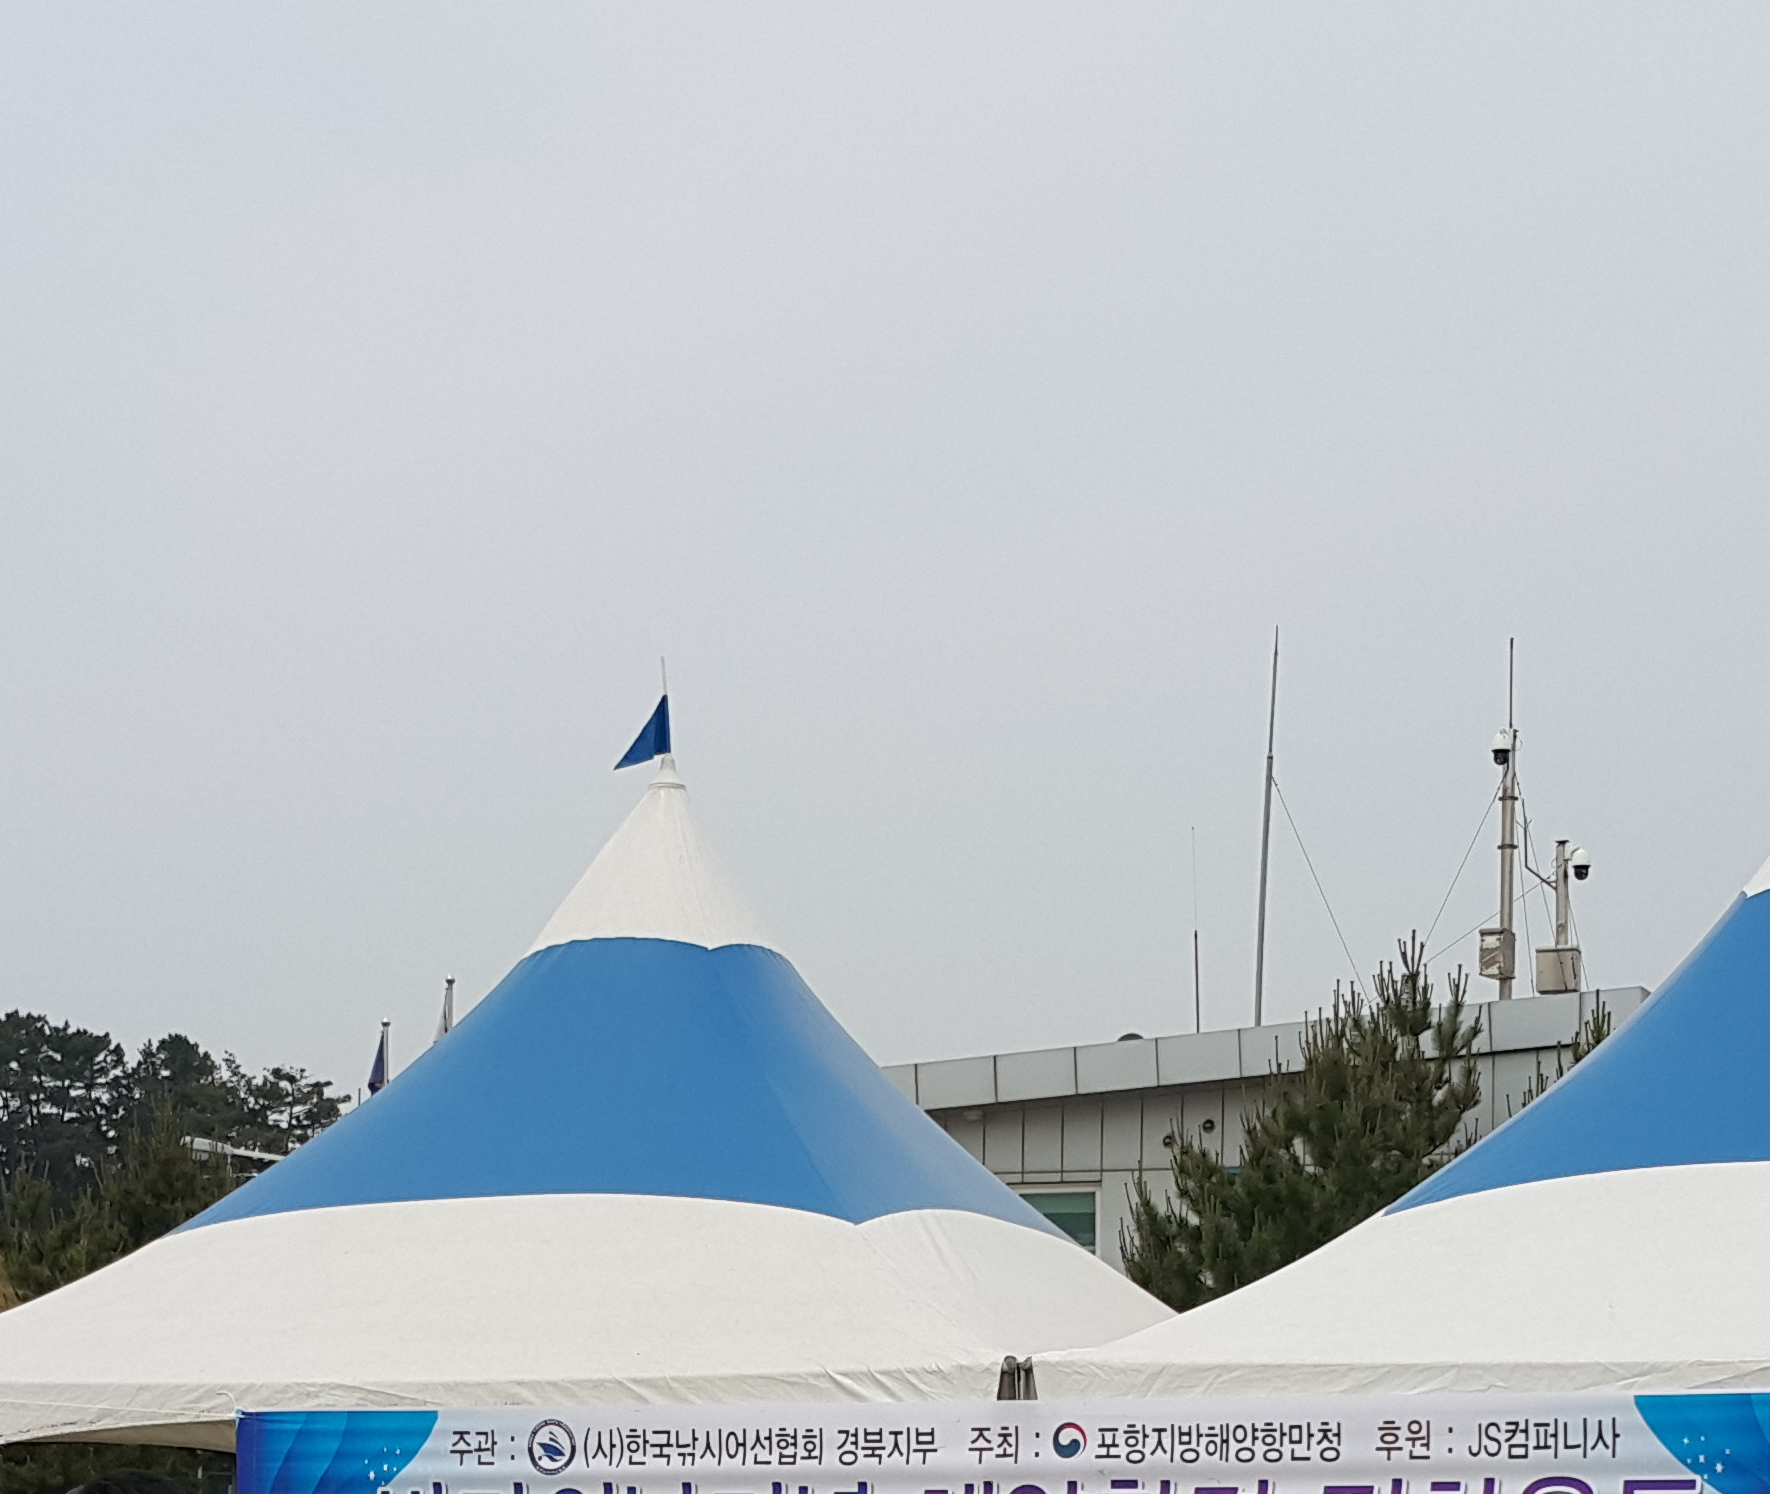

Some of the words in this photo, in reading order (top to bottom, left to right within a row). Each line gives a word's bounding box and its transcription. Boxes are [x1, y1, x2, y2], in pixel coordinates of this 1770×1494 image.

[450, 1429, 498, 1466] 주관
[583, 1426, 824, 1467] (사)한국낚시어선협회
[836, 1427, 938, 1466] 경북지부
[968, 1426, 1021, 1465] 주최
[1094, 1422, 1343, 1465] 포항지방해양항만청
[1375, 1420, 1432, 1460] 후원
[1468, 1416, 1622, 1460] JS컴퍼니사
